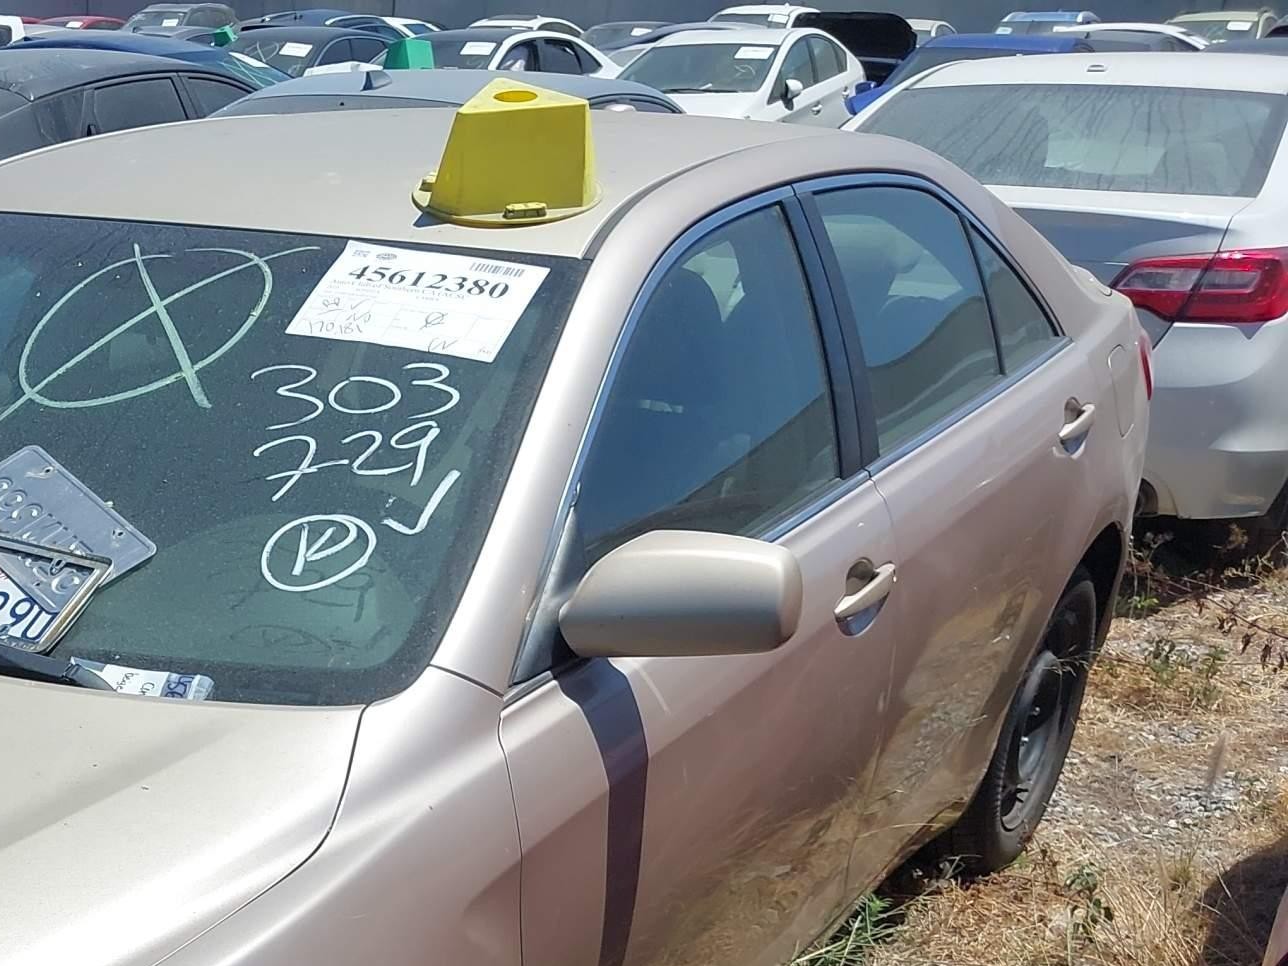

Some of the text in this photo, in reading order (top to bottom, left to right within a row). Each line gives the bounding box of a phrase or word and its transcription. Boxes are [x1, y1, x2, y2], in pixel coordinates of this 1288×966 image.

[348, 265, 509, 299] 45612380
[250, 363, 460, 430] 303
[252, 420, 441, 502] 729
